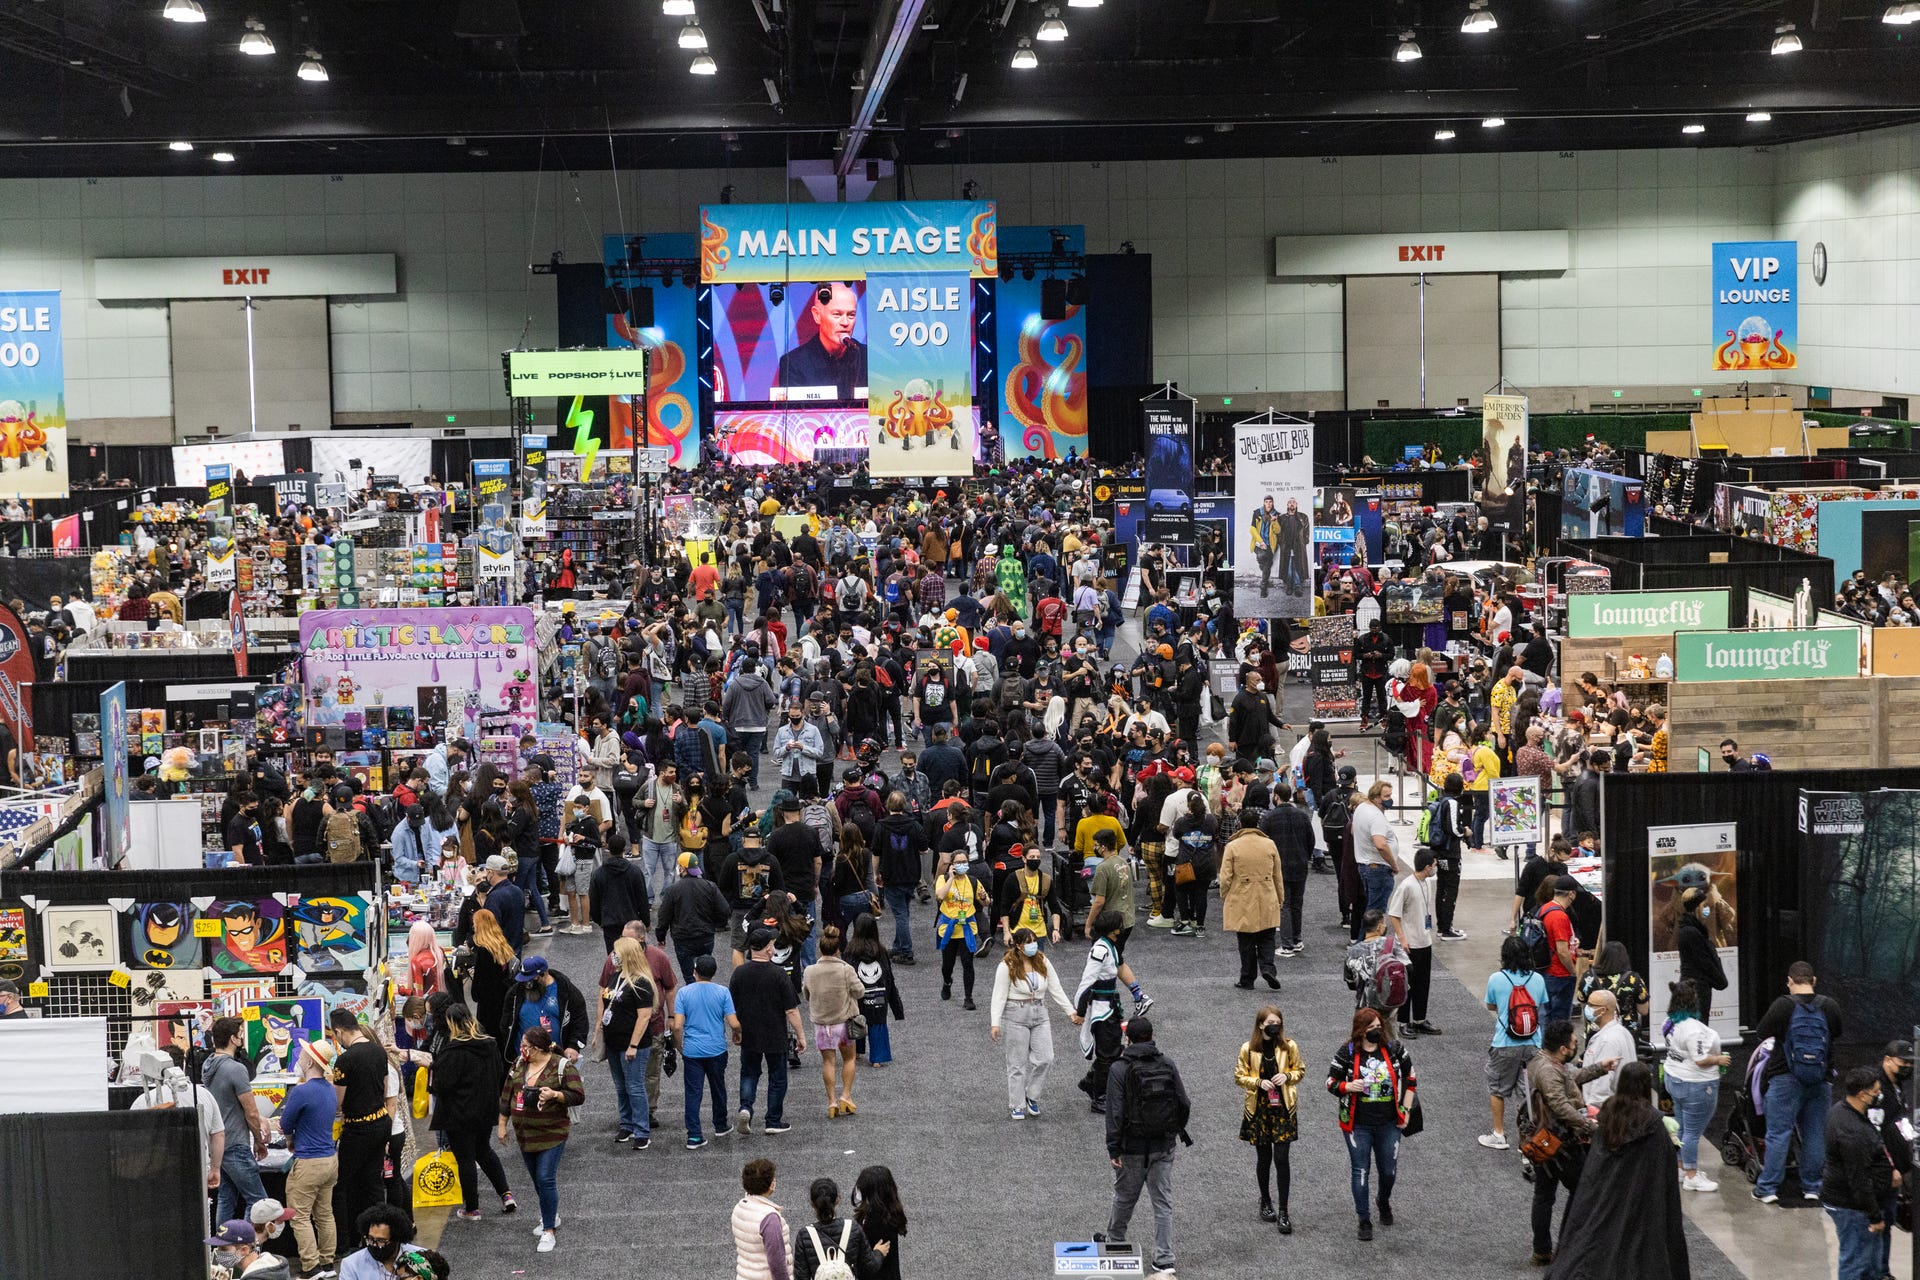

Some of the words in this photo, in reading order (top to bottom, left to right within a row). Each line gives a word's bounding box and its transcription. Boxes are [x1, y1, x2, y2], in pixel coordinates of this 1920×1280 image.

[738, 228, 837, 257] MAIN
[852, 226, 961, 254] STAGE
[1399, 245, 1445, 261] EXIT
[223, 269, 270, 285] EXIT
[1730, 257, 1780, 281] VIP
[877, 287, 960, 313] AISLE
[1720, 288, 1790, 304] LOUNGE
[0, 307, 50, 332] SLE
[889, 322, 949, 347] 900
[0, 342, 40, 367] 00
[1484, 403, 1525, 413] EMPEROR'S
[1496, 412, 1522, 420] BLADES
[1149, 424, 1171, 435] WHITE
[1173, 424, 1188, 435] VAN
[1239, 437, 1257, 455] JAY
[1261, 431, 1288, 453] SILENT
[1291, 429, 1309, 449] BOB
[269, 480, 308, 494] ULLET
[525, 526, 544, 534] stylin
[1315, 530, 1342, 540] TING
[210, 567, 233, 579] stylin
[482, 562, 511, 573] stylin
[1593, 600, 1702, 626] loungefly
[308, 624, 414, 650] ARTISTIC
[416, 624, 525, 645] FLAVORZ
[327, 653, 344, 661] ADD
[345, 653, 373, 661] LITTLE
[374, 652, 408, 661] FLAVOR
[409, 652, 420, 660] TO
[422, 651, 447, 660] YOUR
[449, 651, 487, 659] ARTISTIC
[1705, 639, 1830, 670] loungefly
[1814, 809, 1864, 822] WARS
[1814, 824, 1864, 834] MANDALORIAN
[195, 922, 217, 933] $250
[349, 997, 369, 1016] R-MAN
